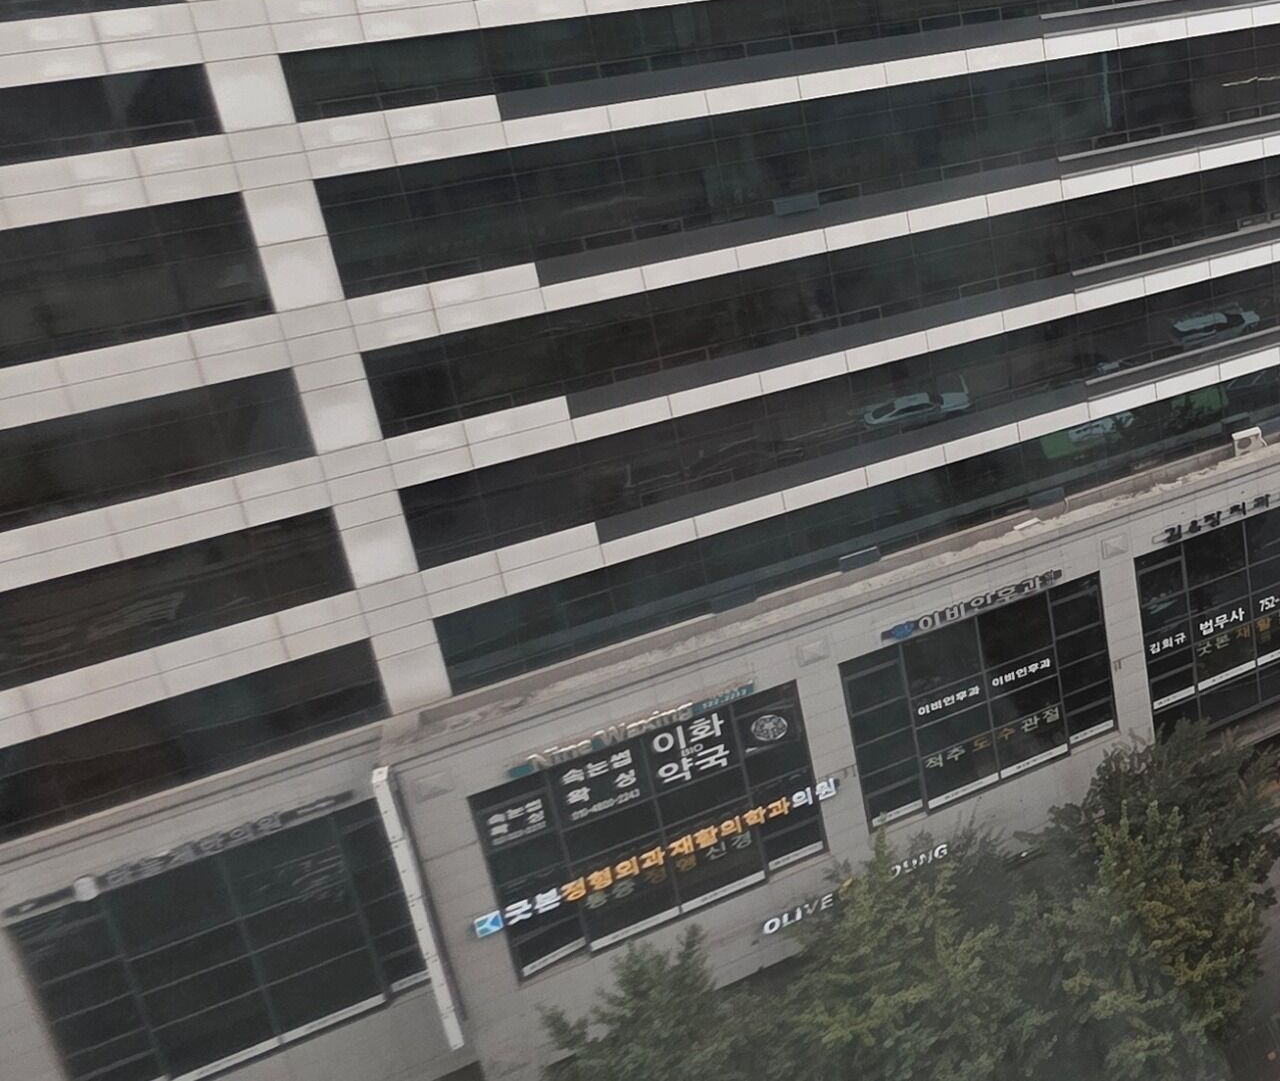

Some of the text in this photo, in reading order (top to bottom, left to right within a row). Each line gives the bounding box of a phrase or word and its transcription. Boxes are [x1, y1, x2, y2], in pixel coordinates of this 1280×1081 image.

[1199, 607, 1246, 636] 법무사
[991, 657, 1052, 688] 이비인후과
[917, 684, 981, 716] 이비인후과
[652, 712, 725, 753] 이화
[657, 743, 730, 784] 약국
[761, 892, 835, 936] OLIVE
